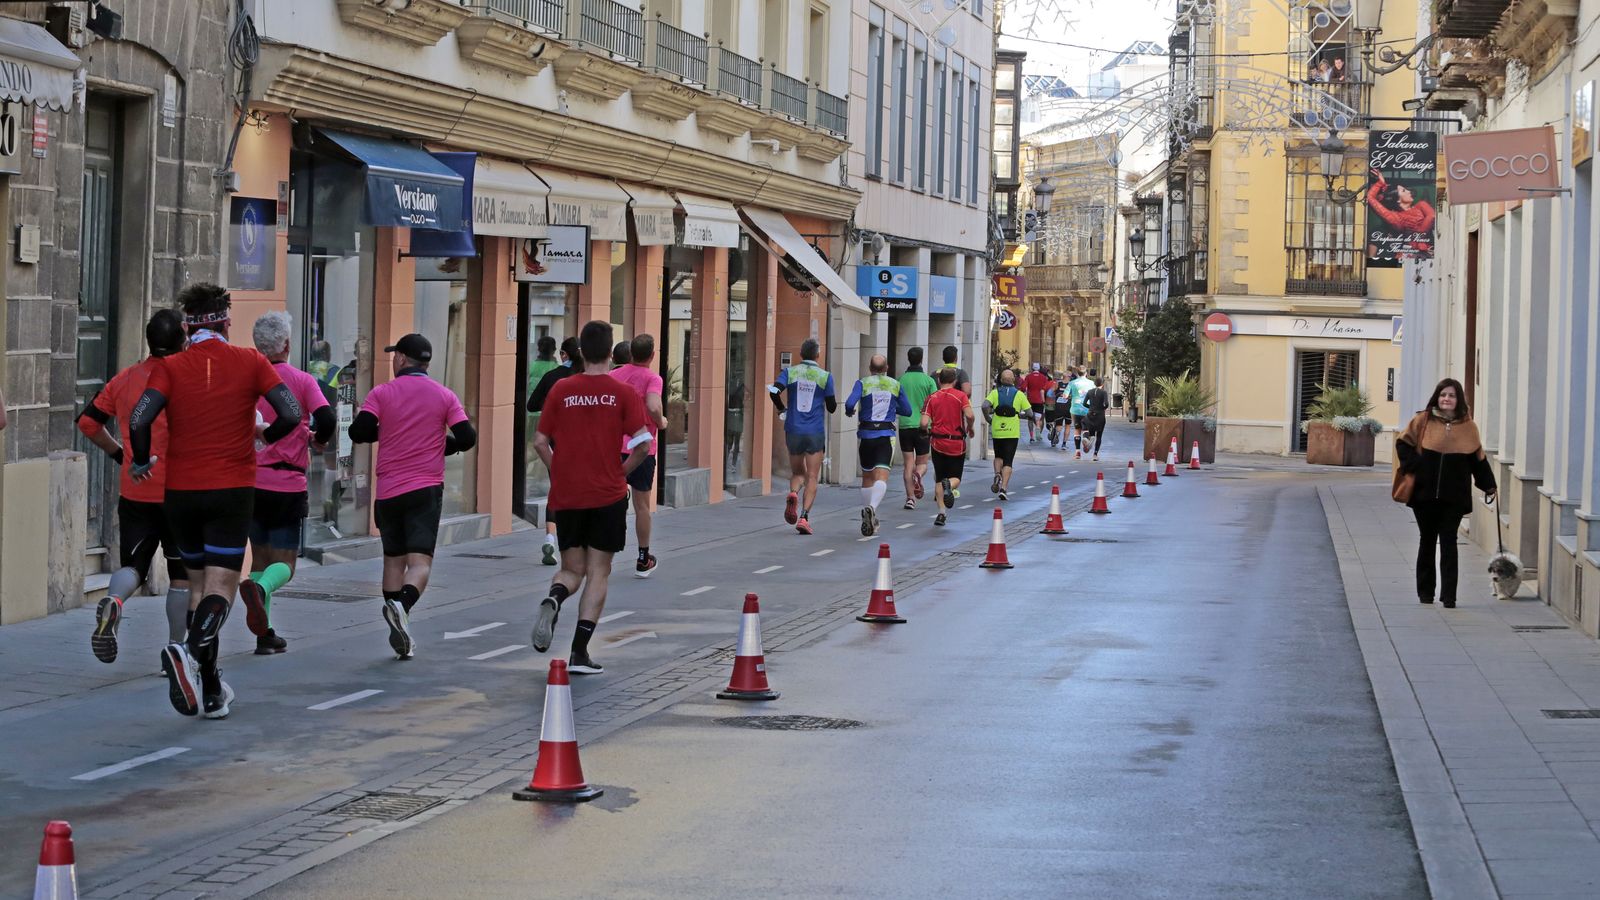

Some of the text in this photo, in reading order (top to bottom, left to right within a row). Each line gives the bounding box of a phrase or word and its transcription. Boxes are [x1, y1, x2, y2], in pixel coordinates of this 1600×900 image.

[0, 59, 32, 94] NDO
[1376, 131, 1429, 149] Tabanco
[1370, 150, 1434, 174] El Pasaje
[1449, 152, 1549, 180] GOCCO
[394, 184, 438, 212] Versiano
[538, 243, 583, 257] Tamara
[891, 273, 909, 295] S
[886, 301, 913, 309] ServiRed
[564, 394, 617, 408] TRIANA C.F.
